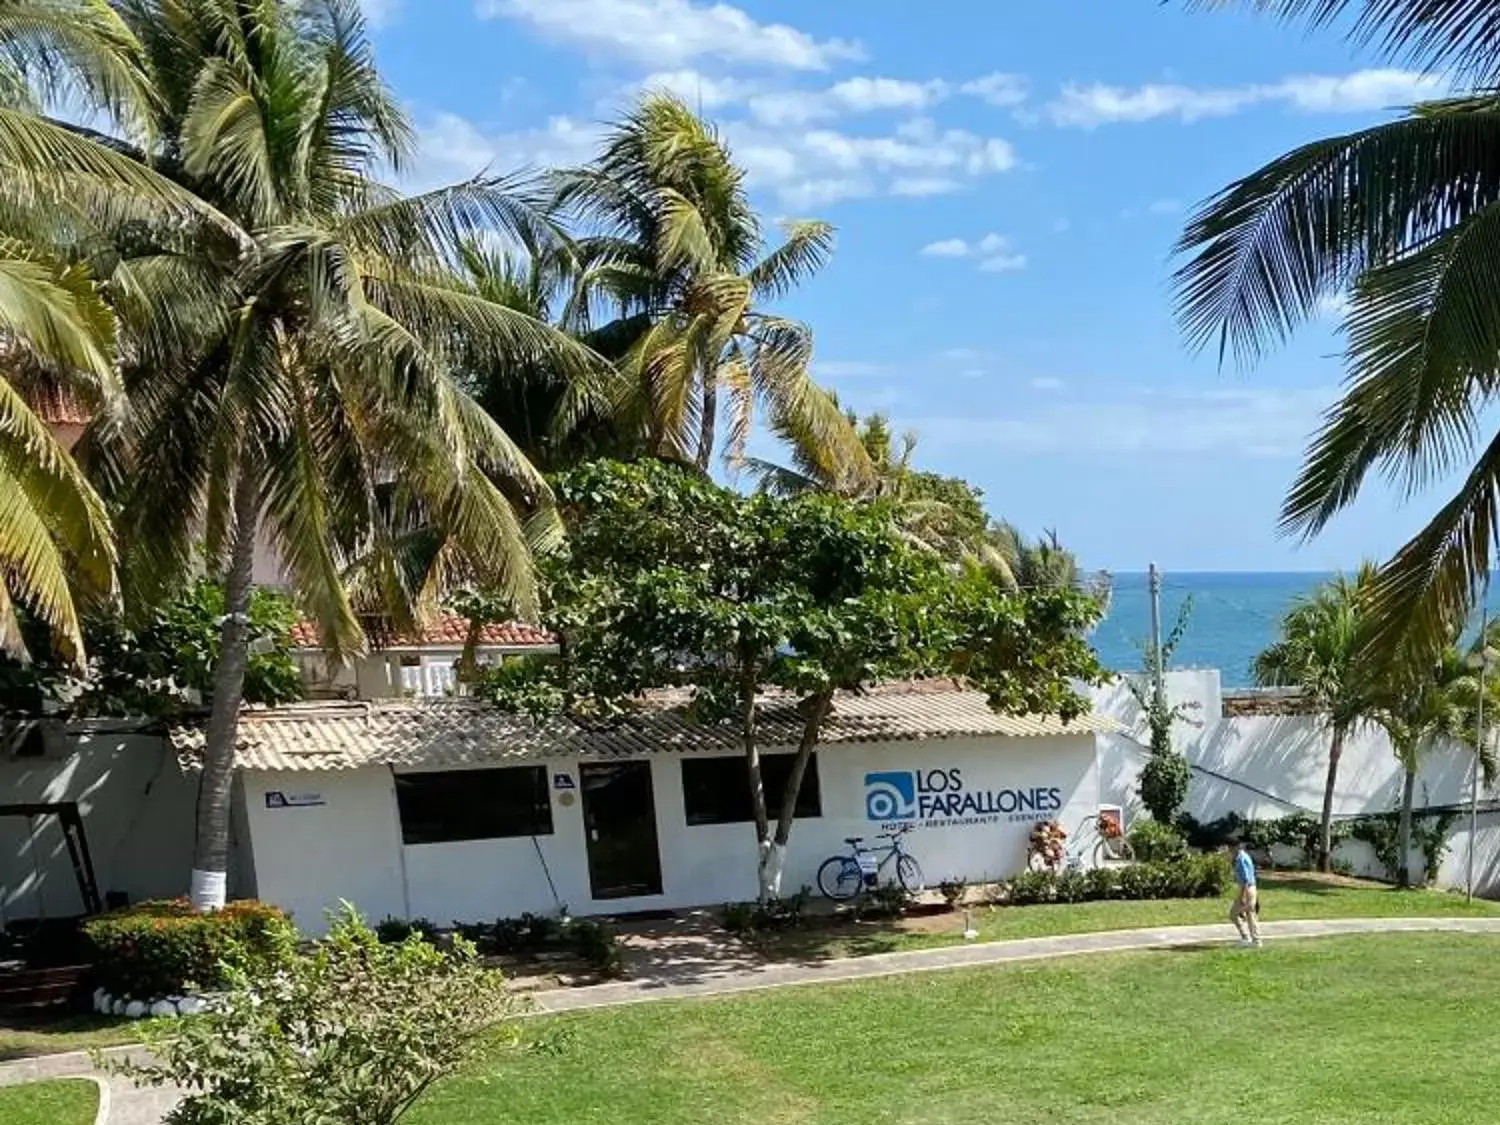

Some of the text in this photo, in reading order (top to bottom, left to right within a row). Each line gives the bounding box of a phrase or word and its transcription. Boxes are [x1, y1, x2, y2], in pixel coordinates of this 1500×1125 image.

[916, 768, 962, 793] LOS
[917, 787, 1062, 818] FARALLONES
[881, 822, 916, 831] HOTEL
